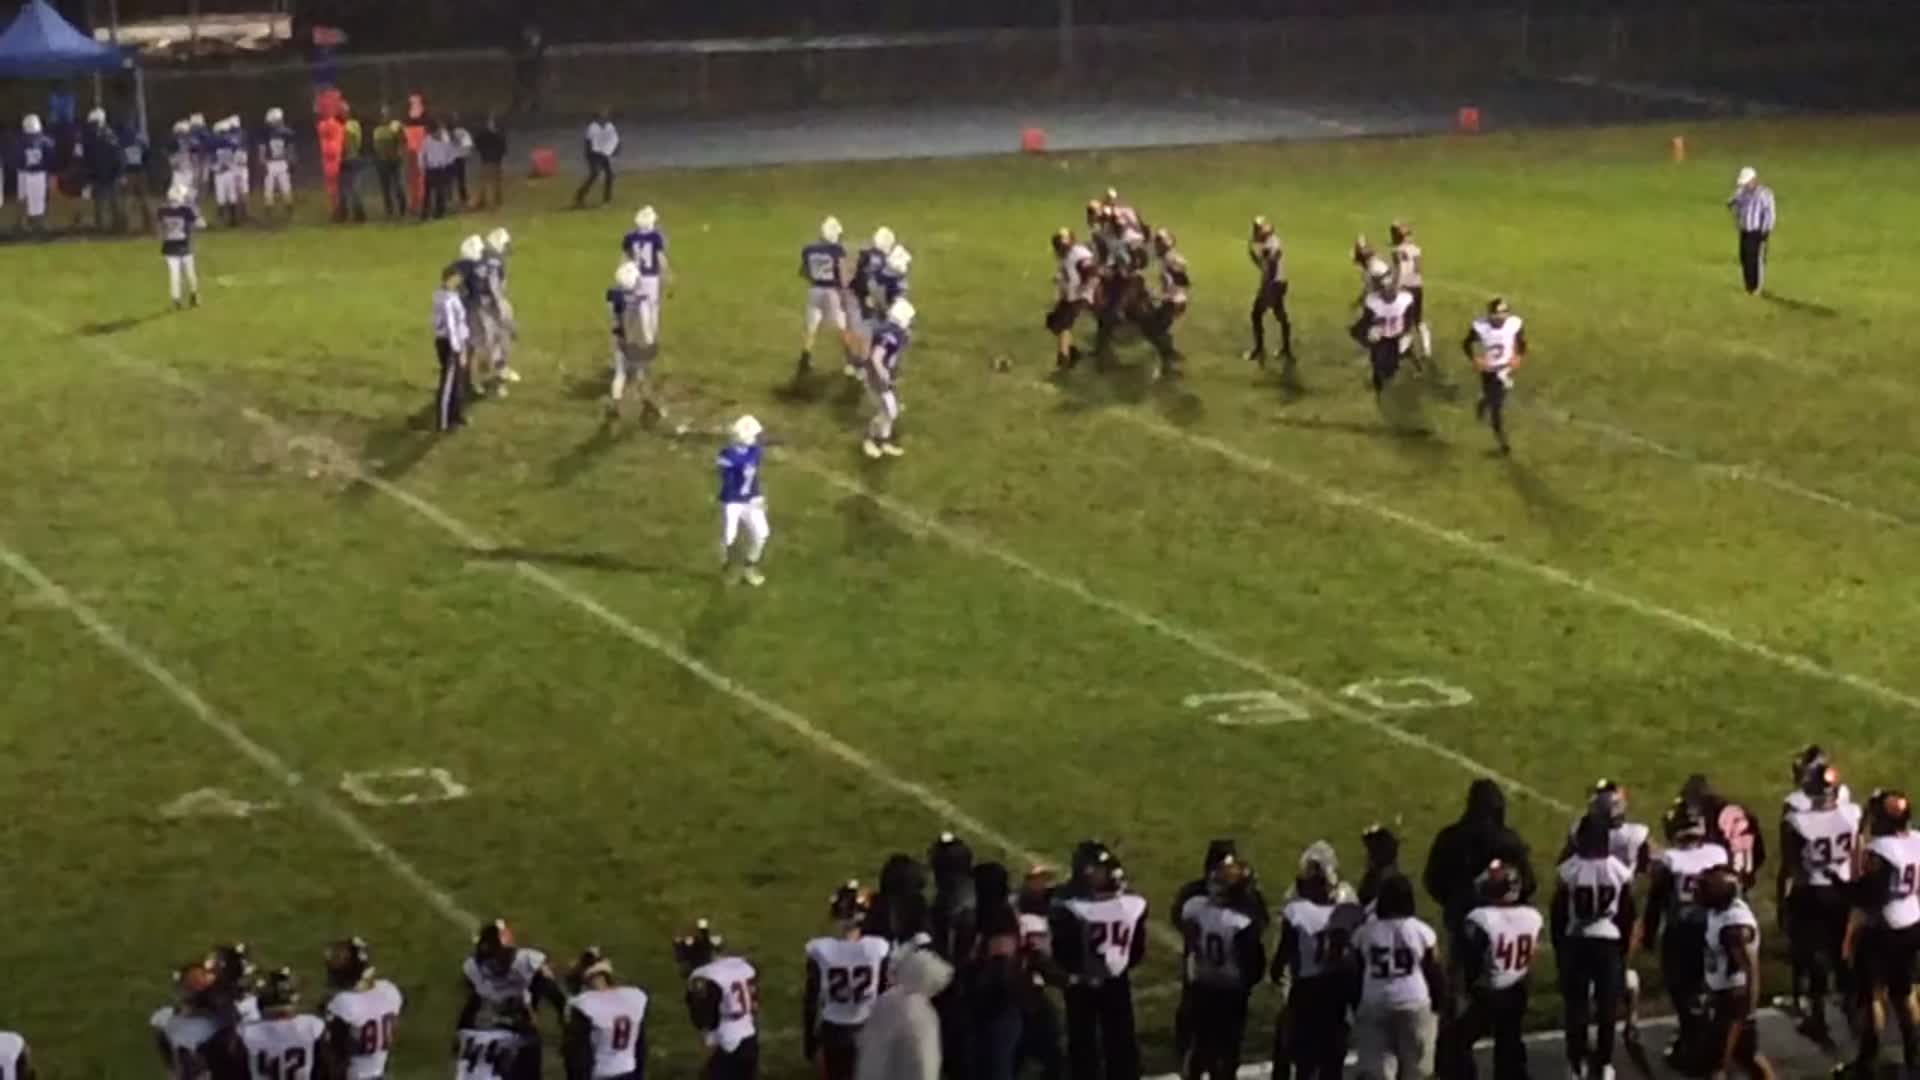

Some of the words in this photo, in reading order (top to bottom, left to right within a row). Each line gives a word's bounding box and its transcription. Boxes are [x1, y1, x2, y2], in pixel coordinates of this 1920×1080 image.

[1088, 920, 1131, 956] 24
[1494, 932, 1537, 971] 48
[1368, 946, 1415, 979] 59
[826, 966, 874, 1003] 22
